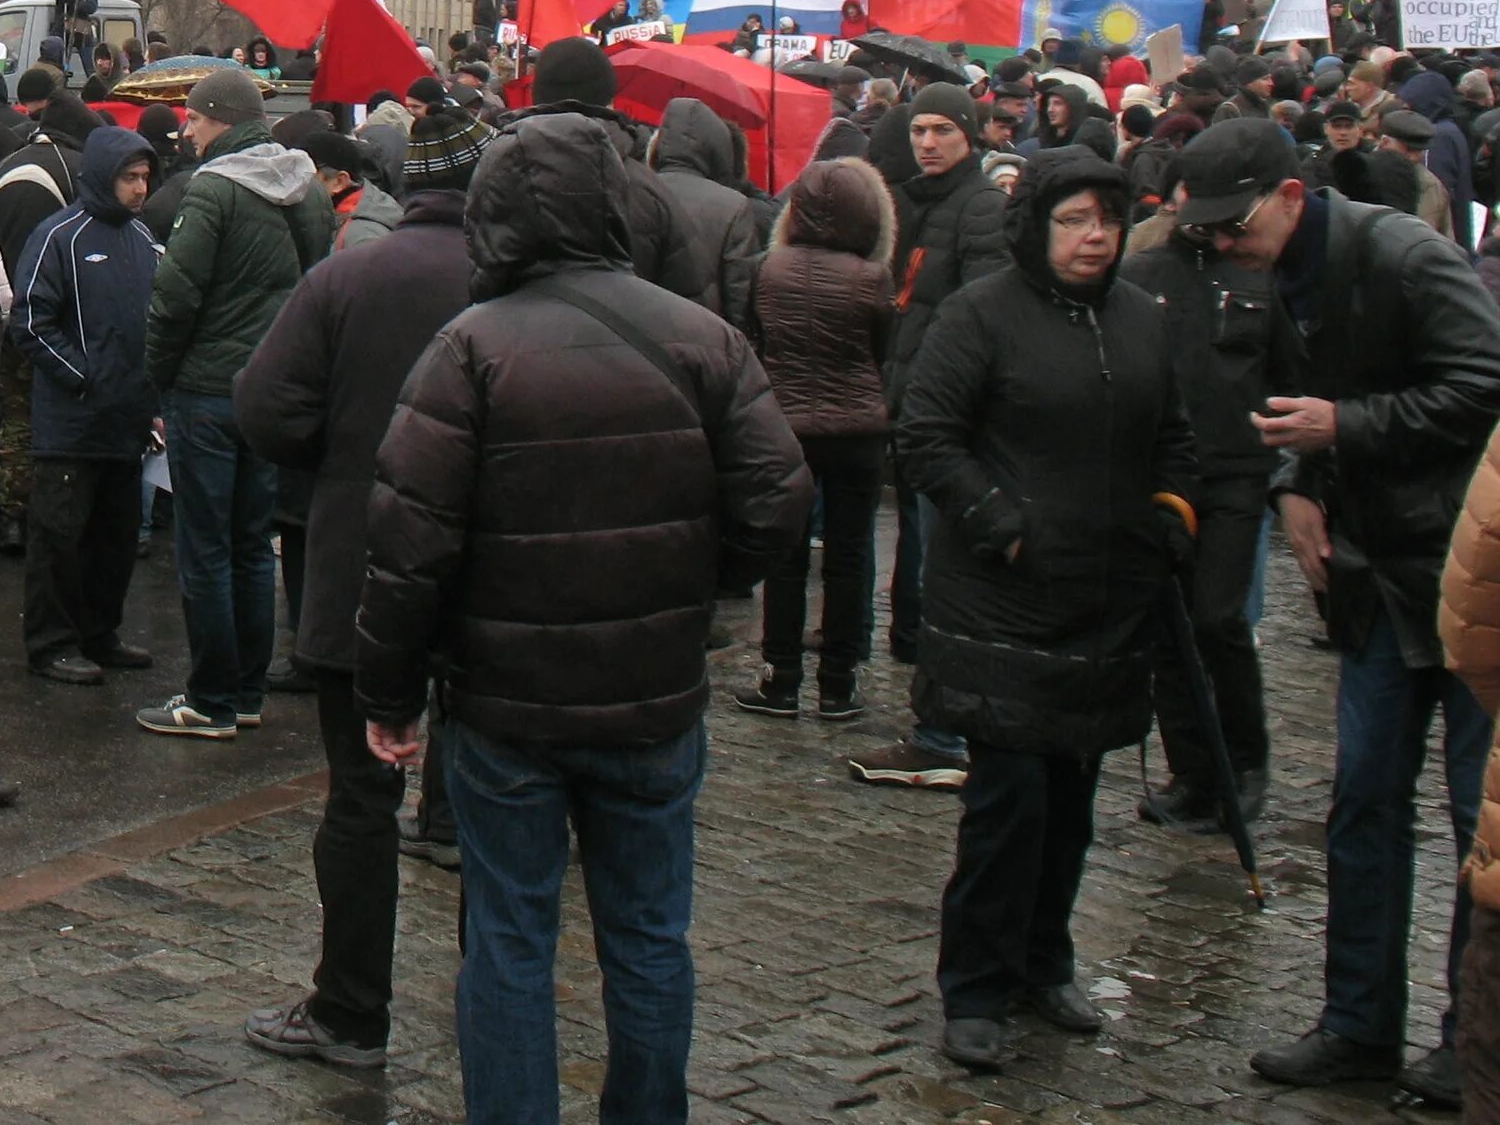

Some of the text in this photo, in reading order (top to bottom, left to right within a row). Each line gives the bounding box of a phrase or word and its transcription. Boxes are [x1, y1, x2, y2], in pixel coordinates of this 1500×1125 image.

[1408, 24, 1469, 44] the EU
[1469, 28, 1493, 46] the
